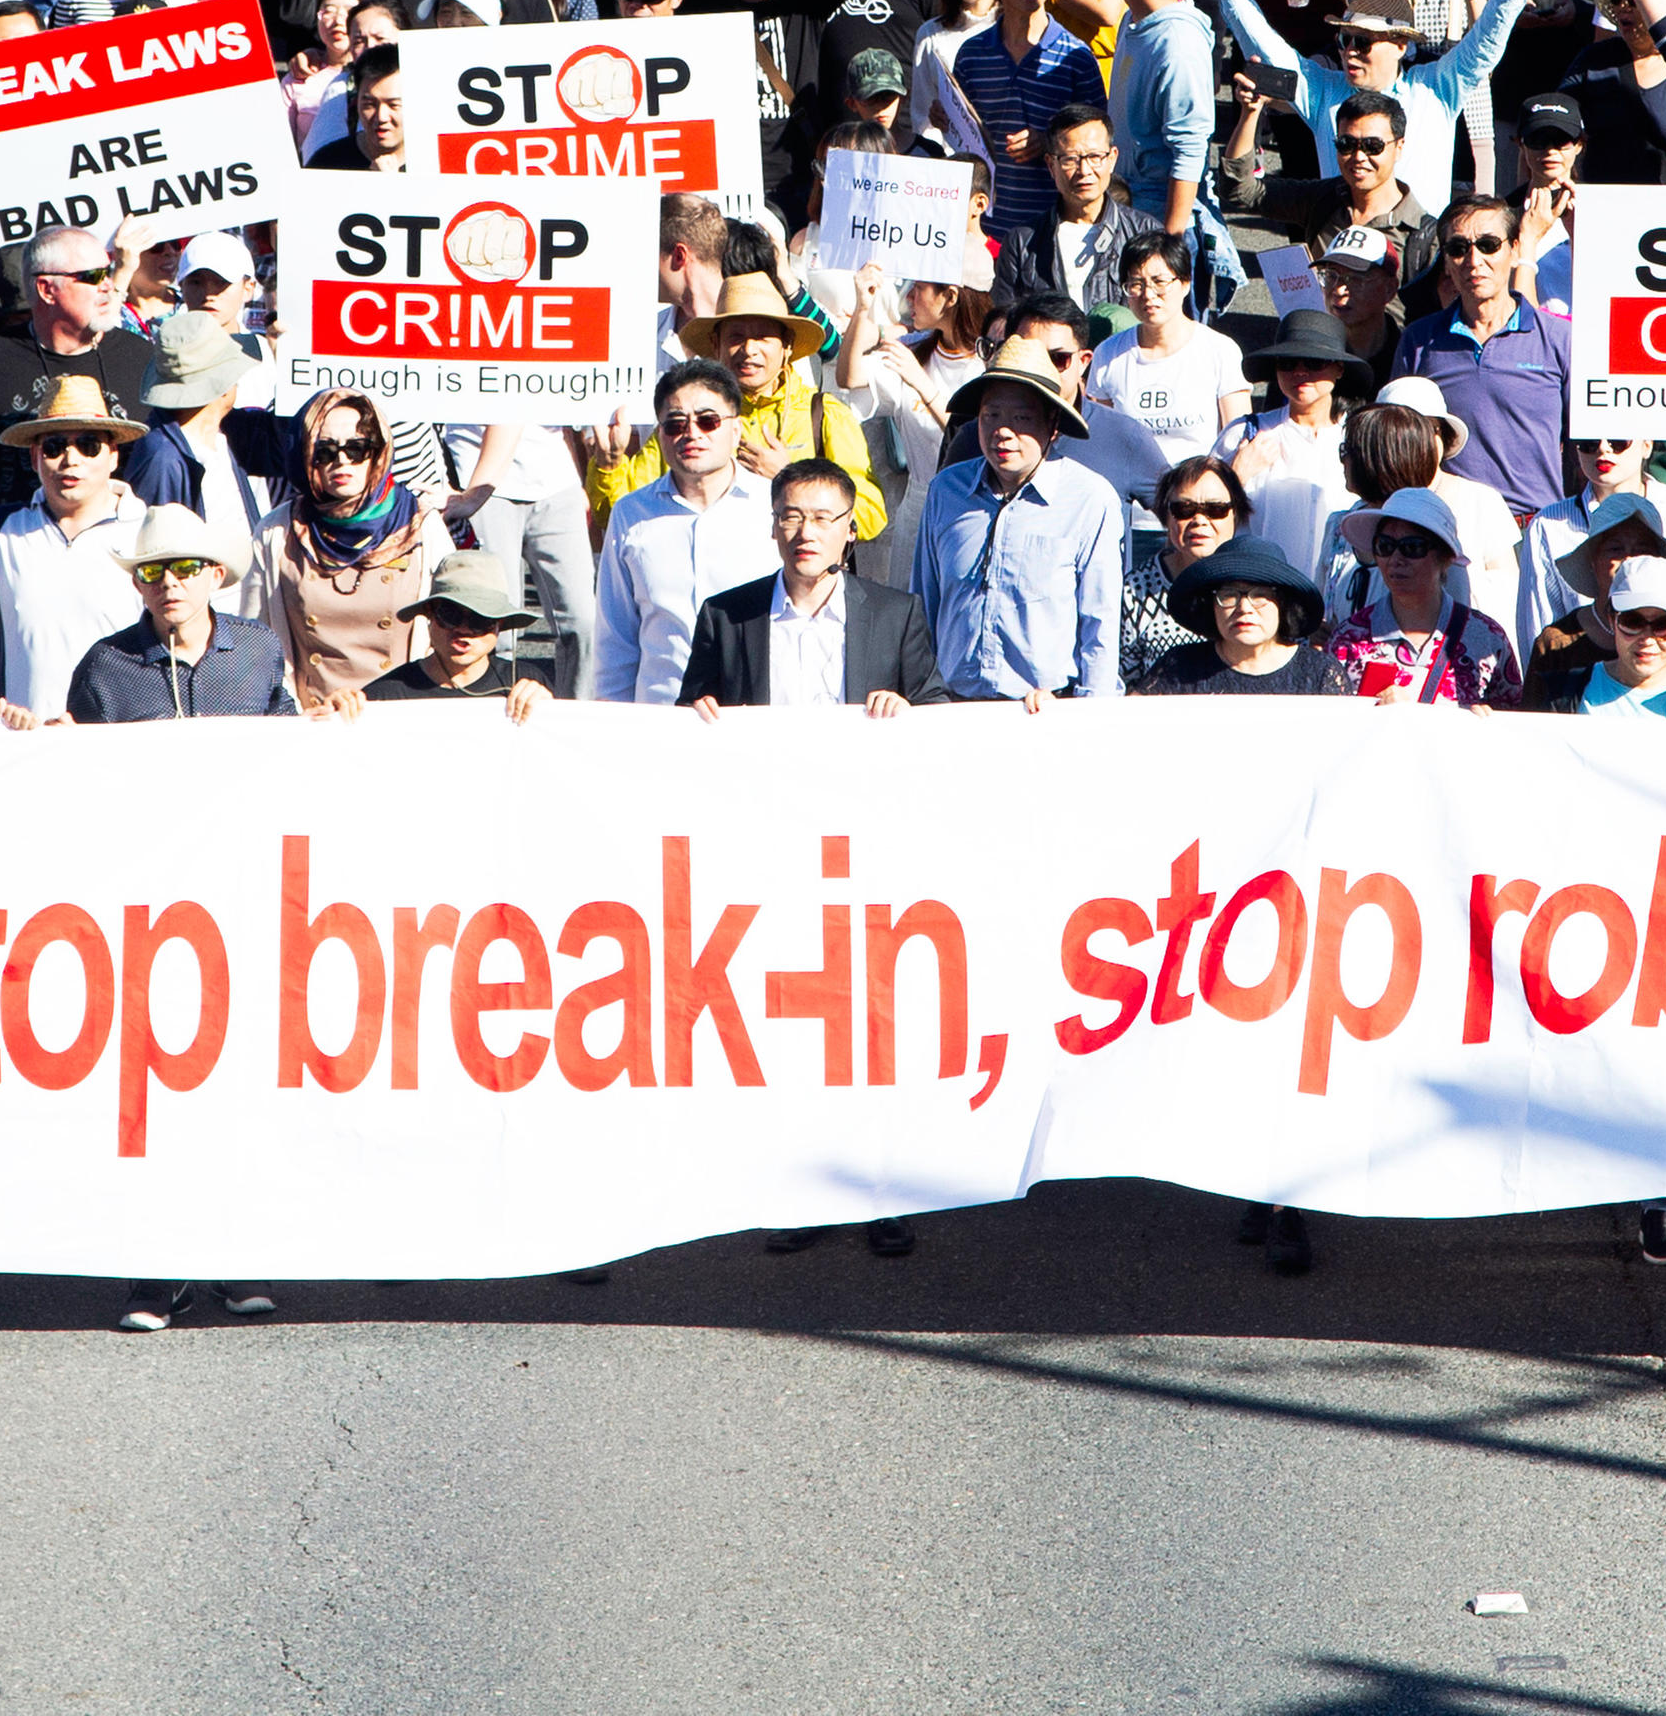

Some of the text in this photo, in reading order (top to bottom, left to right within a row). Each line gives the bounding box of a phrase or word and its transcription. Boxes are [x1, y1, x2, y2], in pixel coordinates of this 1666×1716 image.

[106, 22, 252, 83] LAWS
[68, 128, 167, 180] ARE
[116, 162, 259, 218] LAWS
[852, 175, 961, 202] we are Scared
[335, 201, 589, 283] STOP
[850, 215, 947, 250] Help Us
[339, 289, 574, 350] CR!ME
[290, 357, 645, 402] Enough is Enough!!!
[277, 834, 1009, 1111] break-in,
[1053, 838, 1423, 1096] stop
